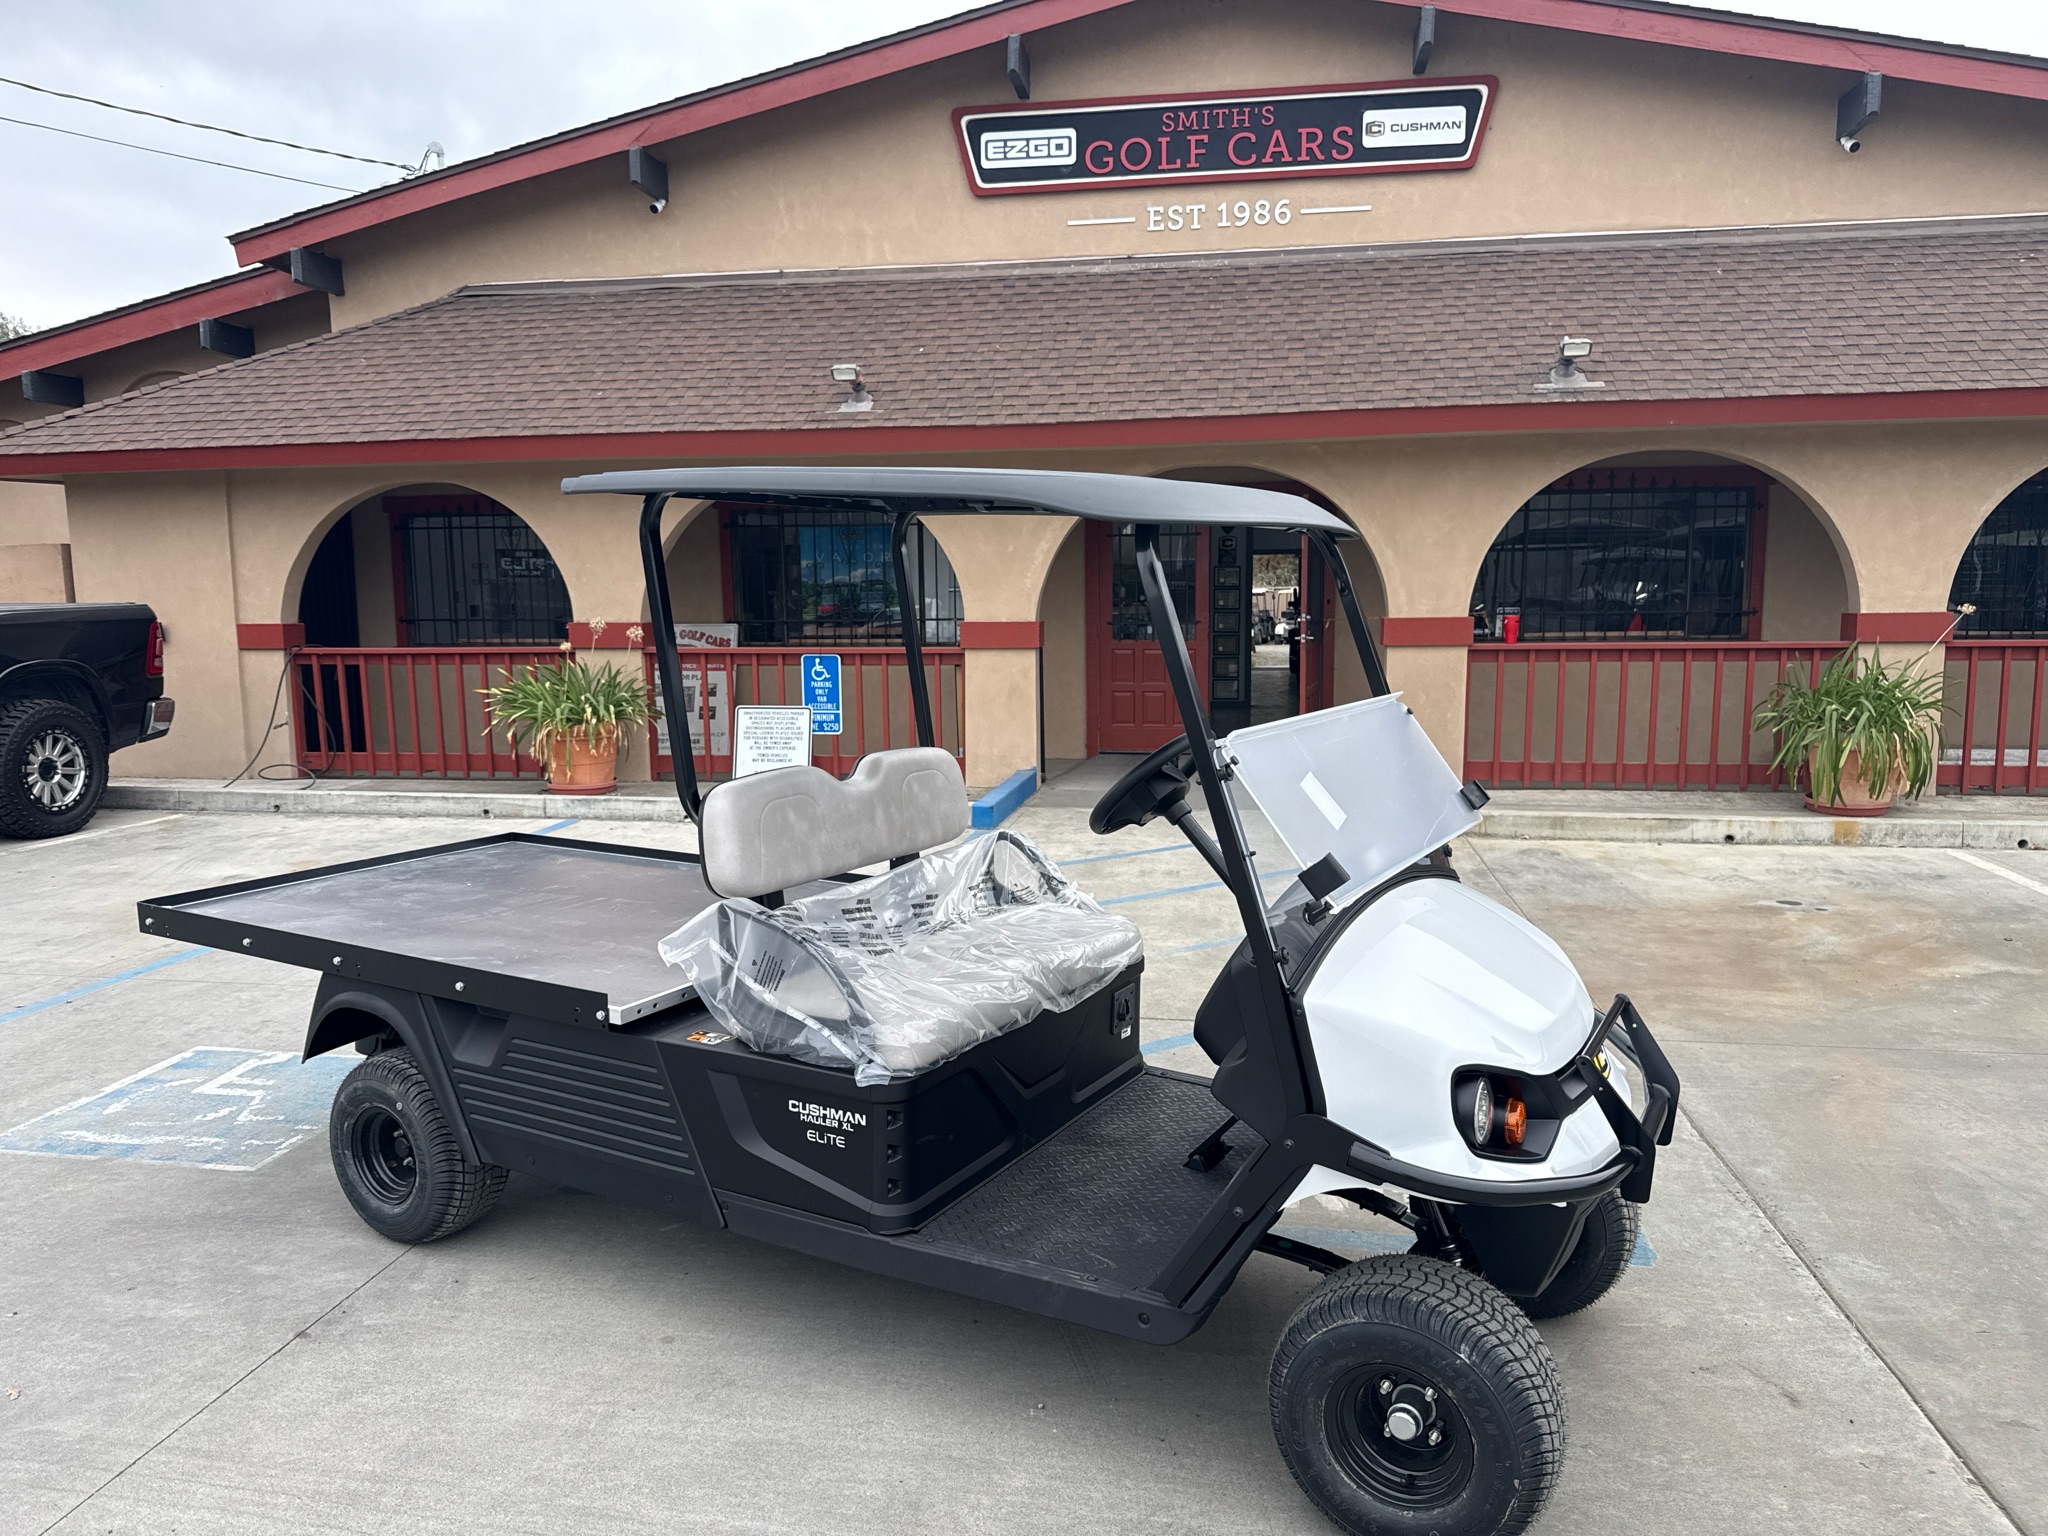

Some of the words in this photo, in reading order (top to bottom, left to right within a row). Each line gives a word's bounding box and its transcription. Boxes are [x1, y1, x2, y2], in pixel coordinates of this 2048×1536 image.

[1162, 105, 1275, 132] SMITH'S
[1390, 120, 1462, 133] CUSHMAN
[1085, 134, 1209, 174] GOLF
[1228, 126, 1354, 166] CARS
[1146, 204, 1206, 231] EST
[1216, 199, 1292, 227] 1986
[679, 629, 706, 642] GOLF
[705, 634, 732, 647] CARS
[810, 680, 832, 688] PARKING
[815, 688, 829, 696] ONLY
[812, 713, 835, 722] INIMUM
[822, 722, 840, 731] $250
[788, 1099, 867, 1126] CUSHMAN
[800, 1113, 839, 1128] HAULER
[842, 1121, 854, 1132] XL
